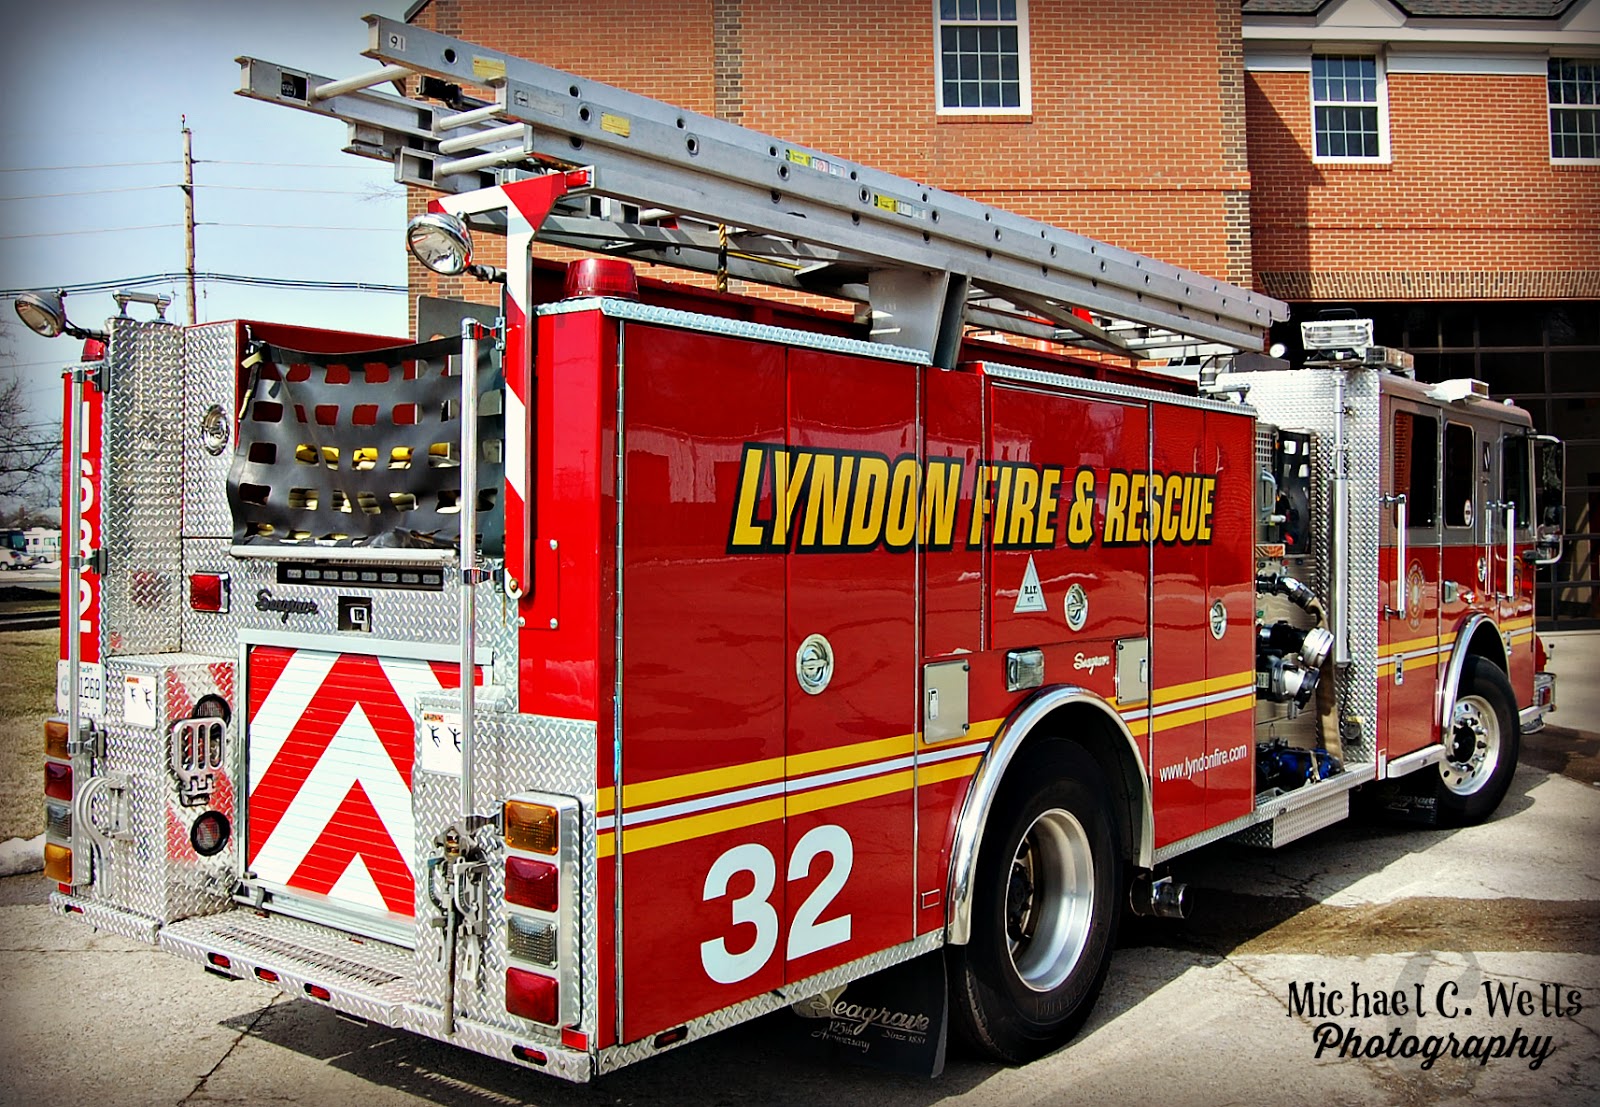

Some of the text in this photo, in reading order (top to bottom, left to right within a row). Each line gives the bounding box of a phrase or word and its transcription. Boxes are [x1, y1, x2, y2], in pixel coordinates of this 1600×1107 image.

[390, 35, 404, 50] 91
[727, 443, 1217, 552] LYNDON FIRE & RESCUE
[1159, 744, 1247, 783] www.lyndonfire.com
[700, 824, 854, 984] 32
